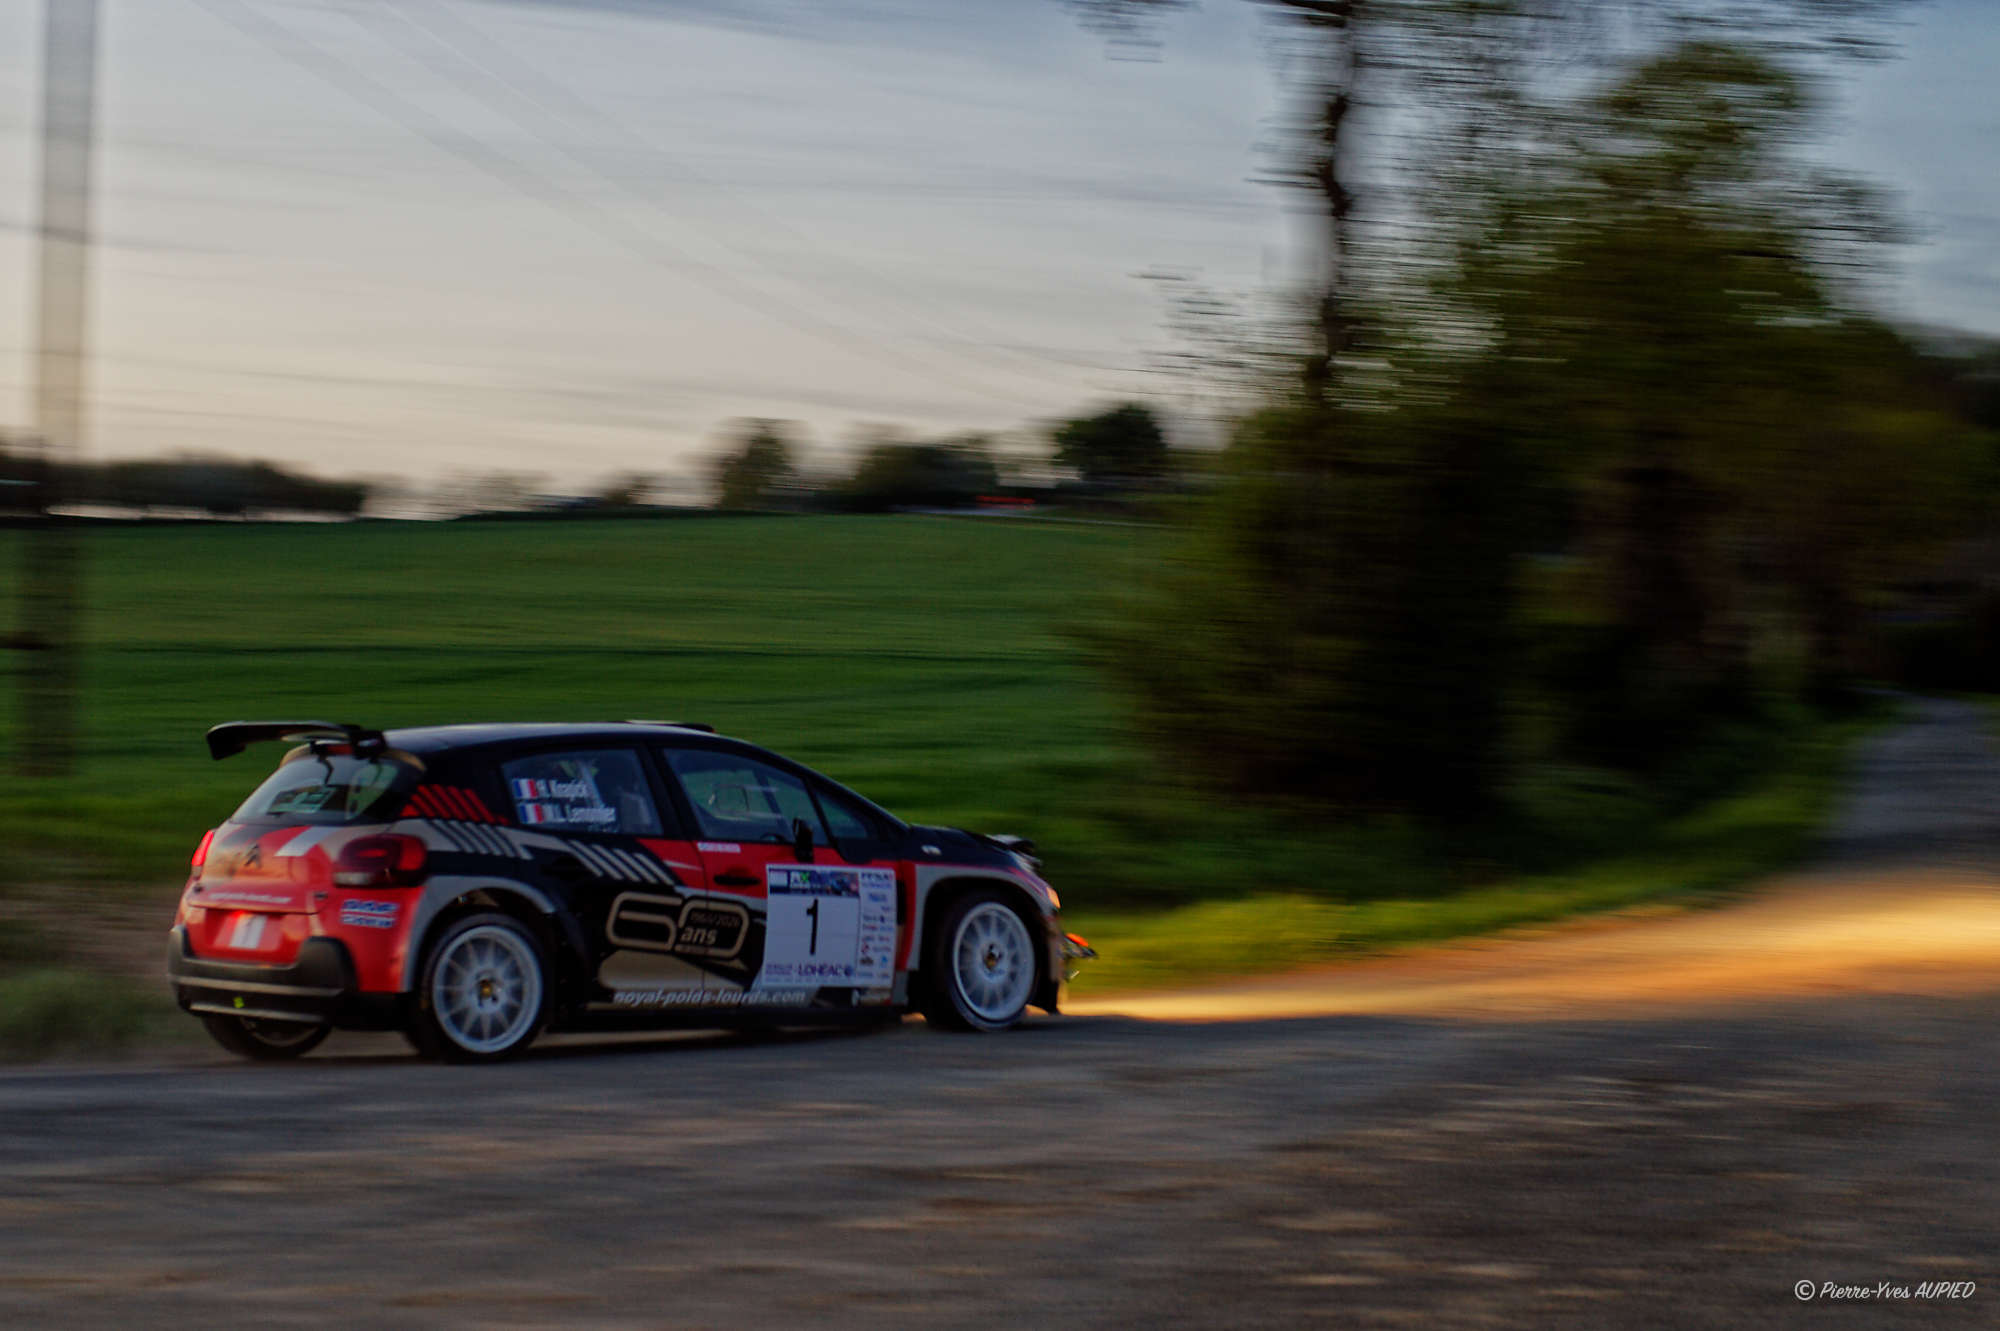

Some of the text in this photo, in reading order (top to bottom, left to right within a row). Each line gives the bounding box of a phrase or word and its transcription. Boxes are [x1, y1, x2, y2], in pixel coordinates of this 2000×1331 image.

[605, 891, 751, 960] 60
[680, 926, 718, 946] ans
[806, 898, 819, 956] 1
[612, 986, 806, 1008] noyal-poids-lourds.com
